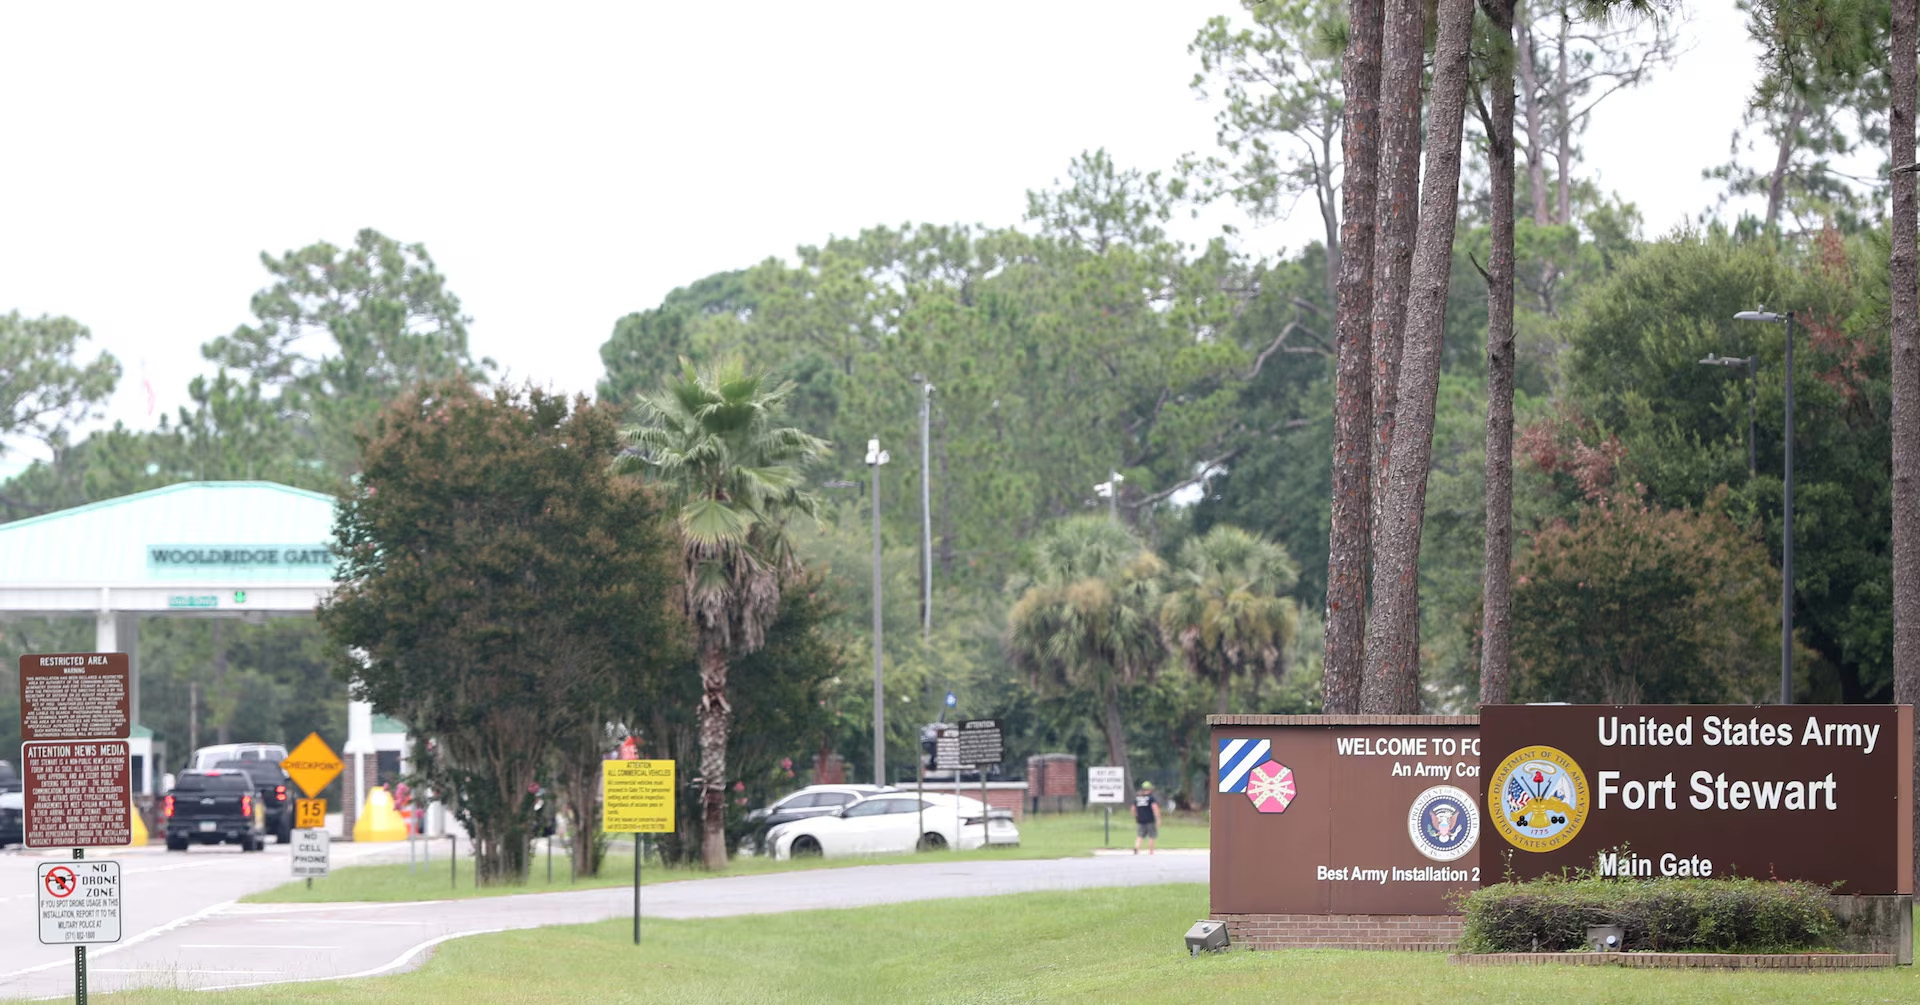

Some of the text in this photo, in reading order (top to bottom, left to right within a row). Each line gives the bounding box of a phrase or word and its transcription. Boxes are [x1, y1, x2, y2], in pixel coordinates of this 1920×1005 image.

[152, 549, 332, 564] WOOLDRIDGE GATE
[40, 656, 108, 666] RESTRICTED AREA
[965, 720, 995, 729] ATTENTION
[1598, 715, 1880, 754] United States Army
[28, 744, 124, 758] ATTENTION NEWS MEDIA
[1337, 738, 1427, 755] WELCOME
[1431, 738, 1456, 756] TO
[285, 761, 339, 769] CHECKPOINT
[1392, 762, 1411, 776] An
[1414, 762, 1452, 780] Army
[1494, 751, 1536, 793] DEPARTMENT
[1555, 755, 1571, 769] THE
[1572, 771, 1585, 796] ARMY
[1597, 770, 1837, 810] Fort Stewart
[302, 803, 320, 816] 15
[1412, 789, 1442, 820] PRESIDENT
[1464, 798, 1478, 828] UNITED
[1494, 802, 1584, 847] UNITED STATES OF AMERICA
[1450, 836, 1474, 856] STATES
[92, 864, 107, 872] NO
[1600, 853, 1712, 876] Main Gate
[82, 876, 117, 885] DRONE
[1317, 866, 1480, 884] Best Army Installation 2
[86, 888, 114, 897] ZONE
